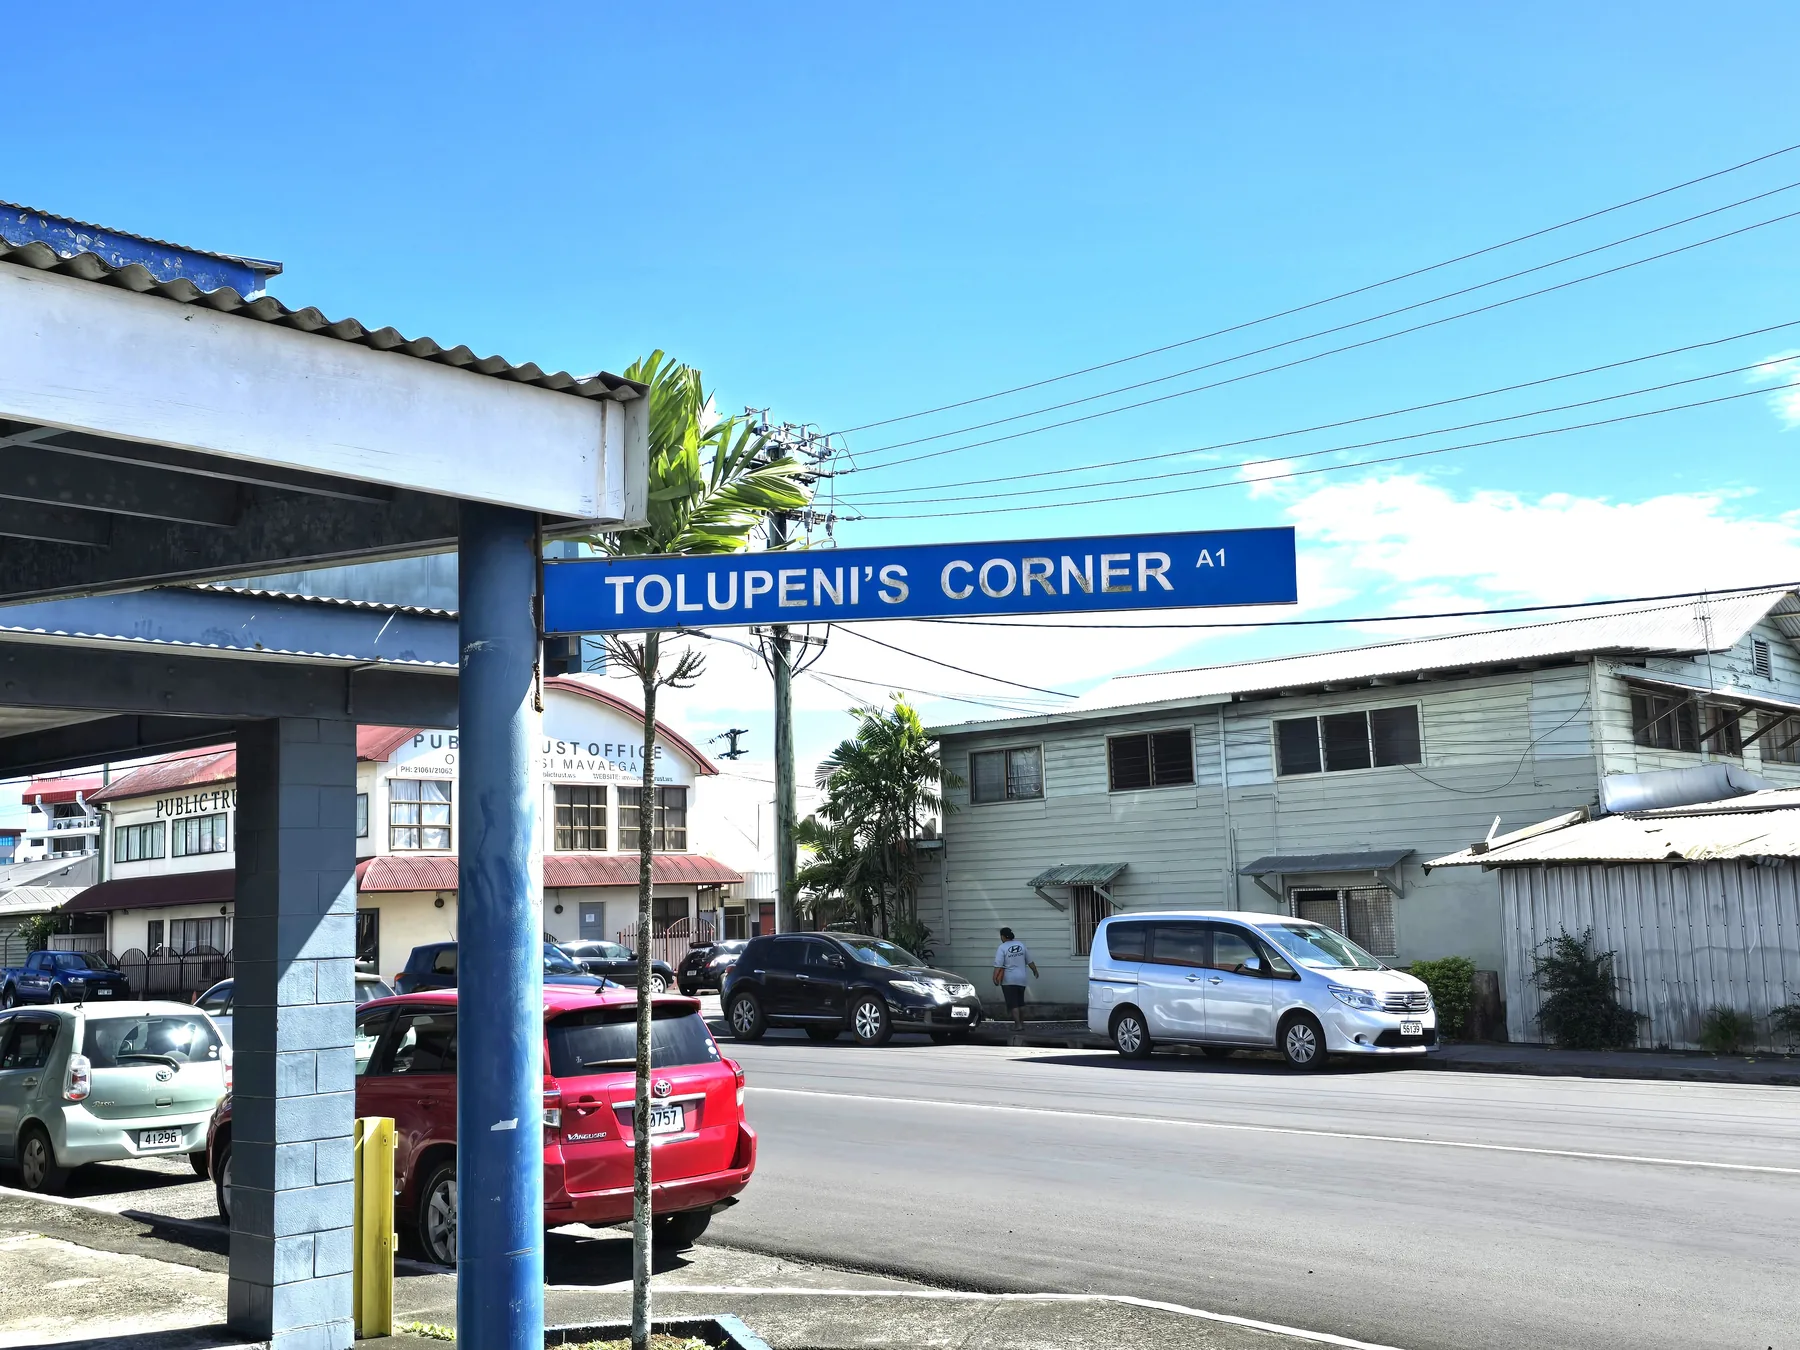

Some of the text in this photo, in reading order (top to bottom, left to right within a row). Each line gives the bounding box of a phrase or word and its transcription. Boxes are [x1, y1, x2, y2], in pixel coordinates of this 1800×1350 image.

[604, 548, 1226, 615] TOLUPENI'S CORNER A1
[413, 733, 662, 759] PUB UST OFFICE
[563, 758, 637, 772] MAVAEGA
[155, 788, 237, 819] PUBLIC TRU
[145, 1131, 177, 1145] 41296
